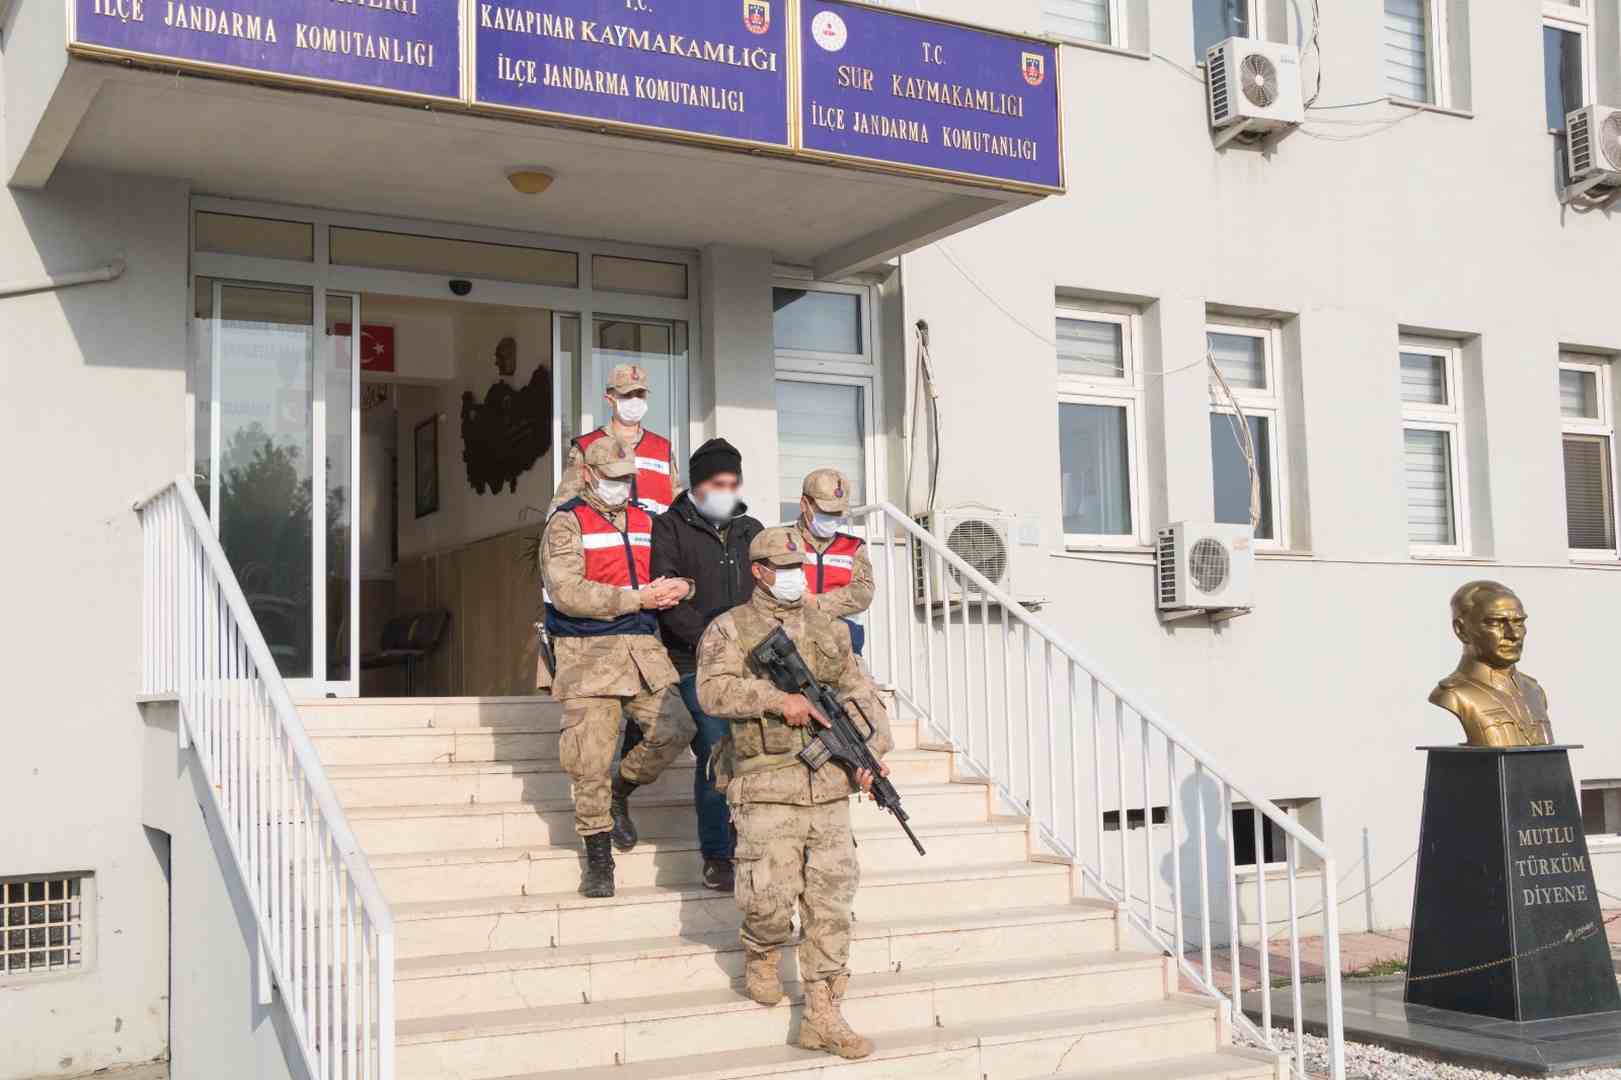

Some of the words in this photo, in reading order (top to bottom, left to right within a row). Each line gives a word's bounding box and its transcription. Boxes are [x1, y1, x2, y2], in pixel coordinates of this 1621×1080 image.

[165, 1, 277, 43] JANDARMA
[480, 4, 575, 41] KAYAPINAR
[581, 20, 777, 72] KAYMAKAMLIĞI
[921, 41, 946, 65] T.C.
[497, 52, 537, 87] İLÇE
[543, 63, 629, 97] JANDARMA
[837, 65, 874, 91] SUR
[811, 100, 845, 132] İLÇE
[853, 111, 929, 144] JANDARMA
[1530, 800, 1555, 817] NE
[1518, 827, 1575, 847] MUTLU
[1516, 853, 1586, 877] TÜRKÜM
[1524, 883, 1588, 906] DİYENE
